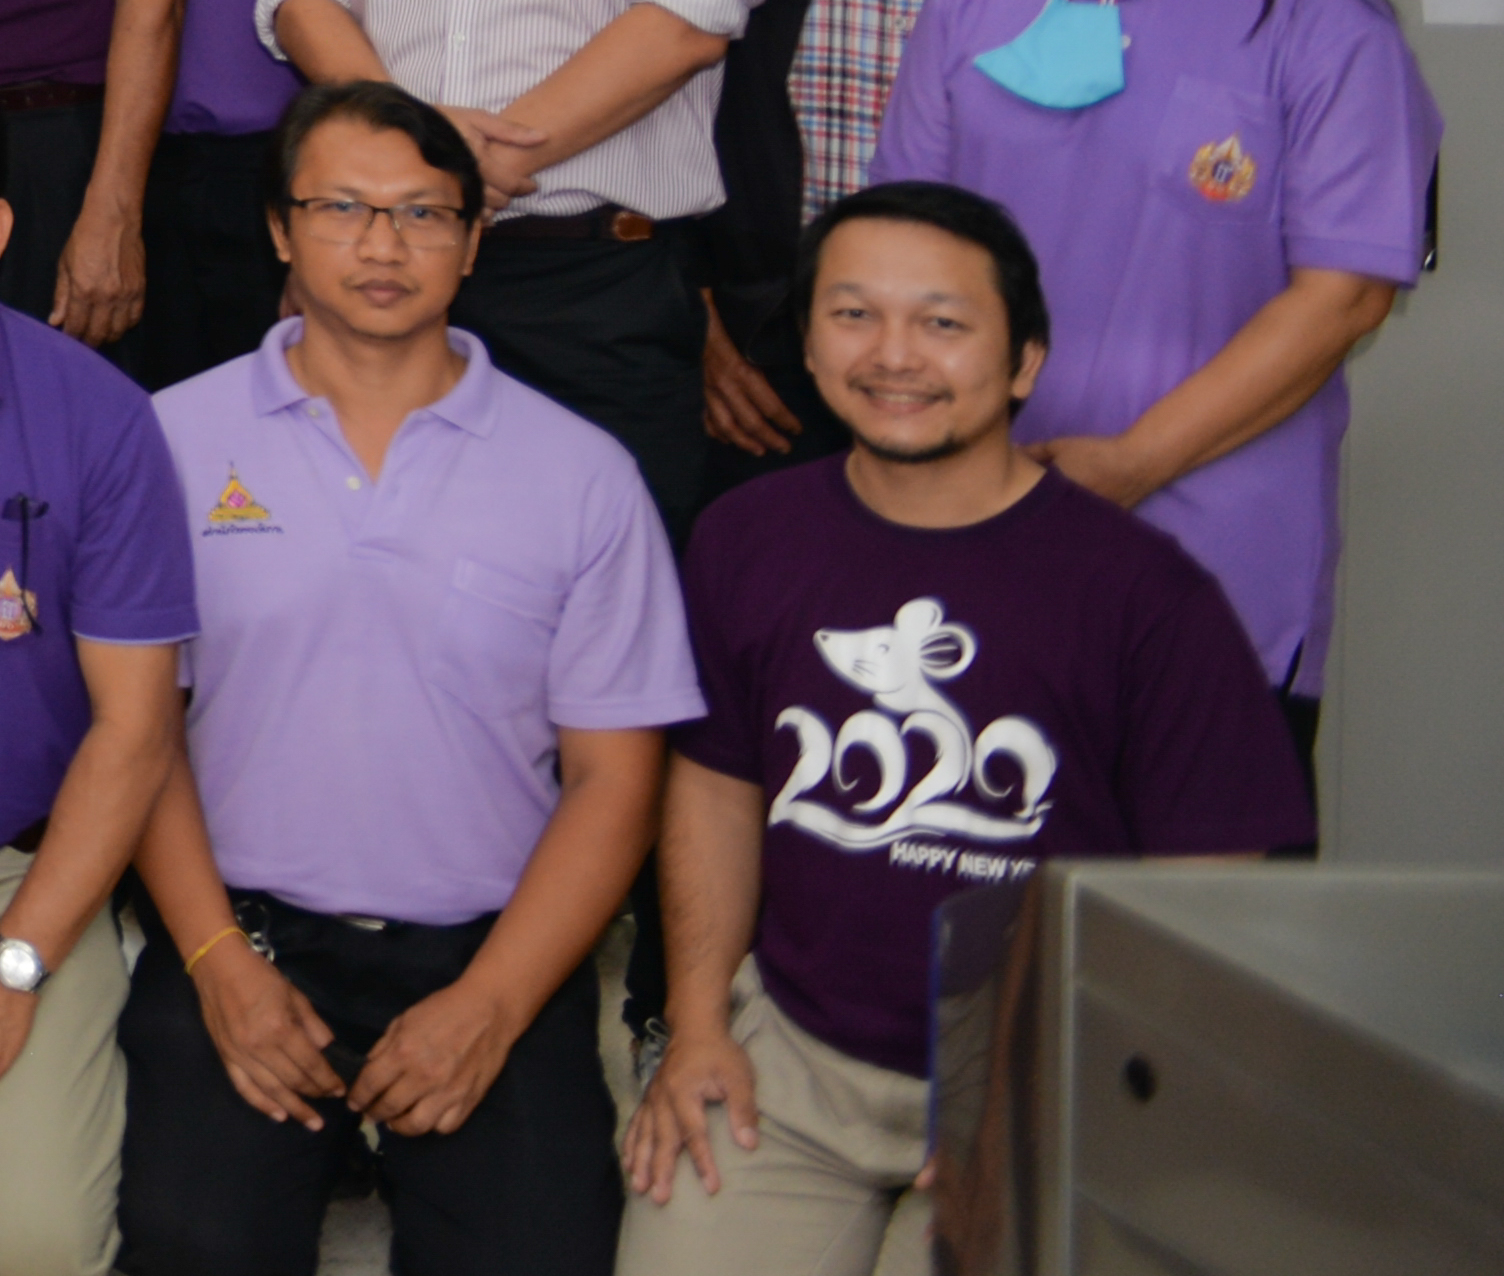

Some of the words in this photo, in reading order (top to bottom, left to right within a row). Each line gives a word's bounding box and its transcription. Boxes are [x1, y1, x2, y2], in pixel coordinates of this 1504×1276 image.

[768, 706, 1057, 851] 2020
[890, 841, 959, 873] HAPPY
[958, 852, 1008, 882] NEW
[1010, 858, 1036, 880] YE
